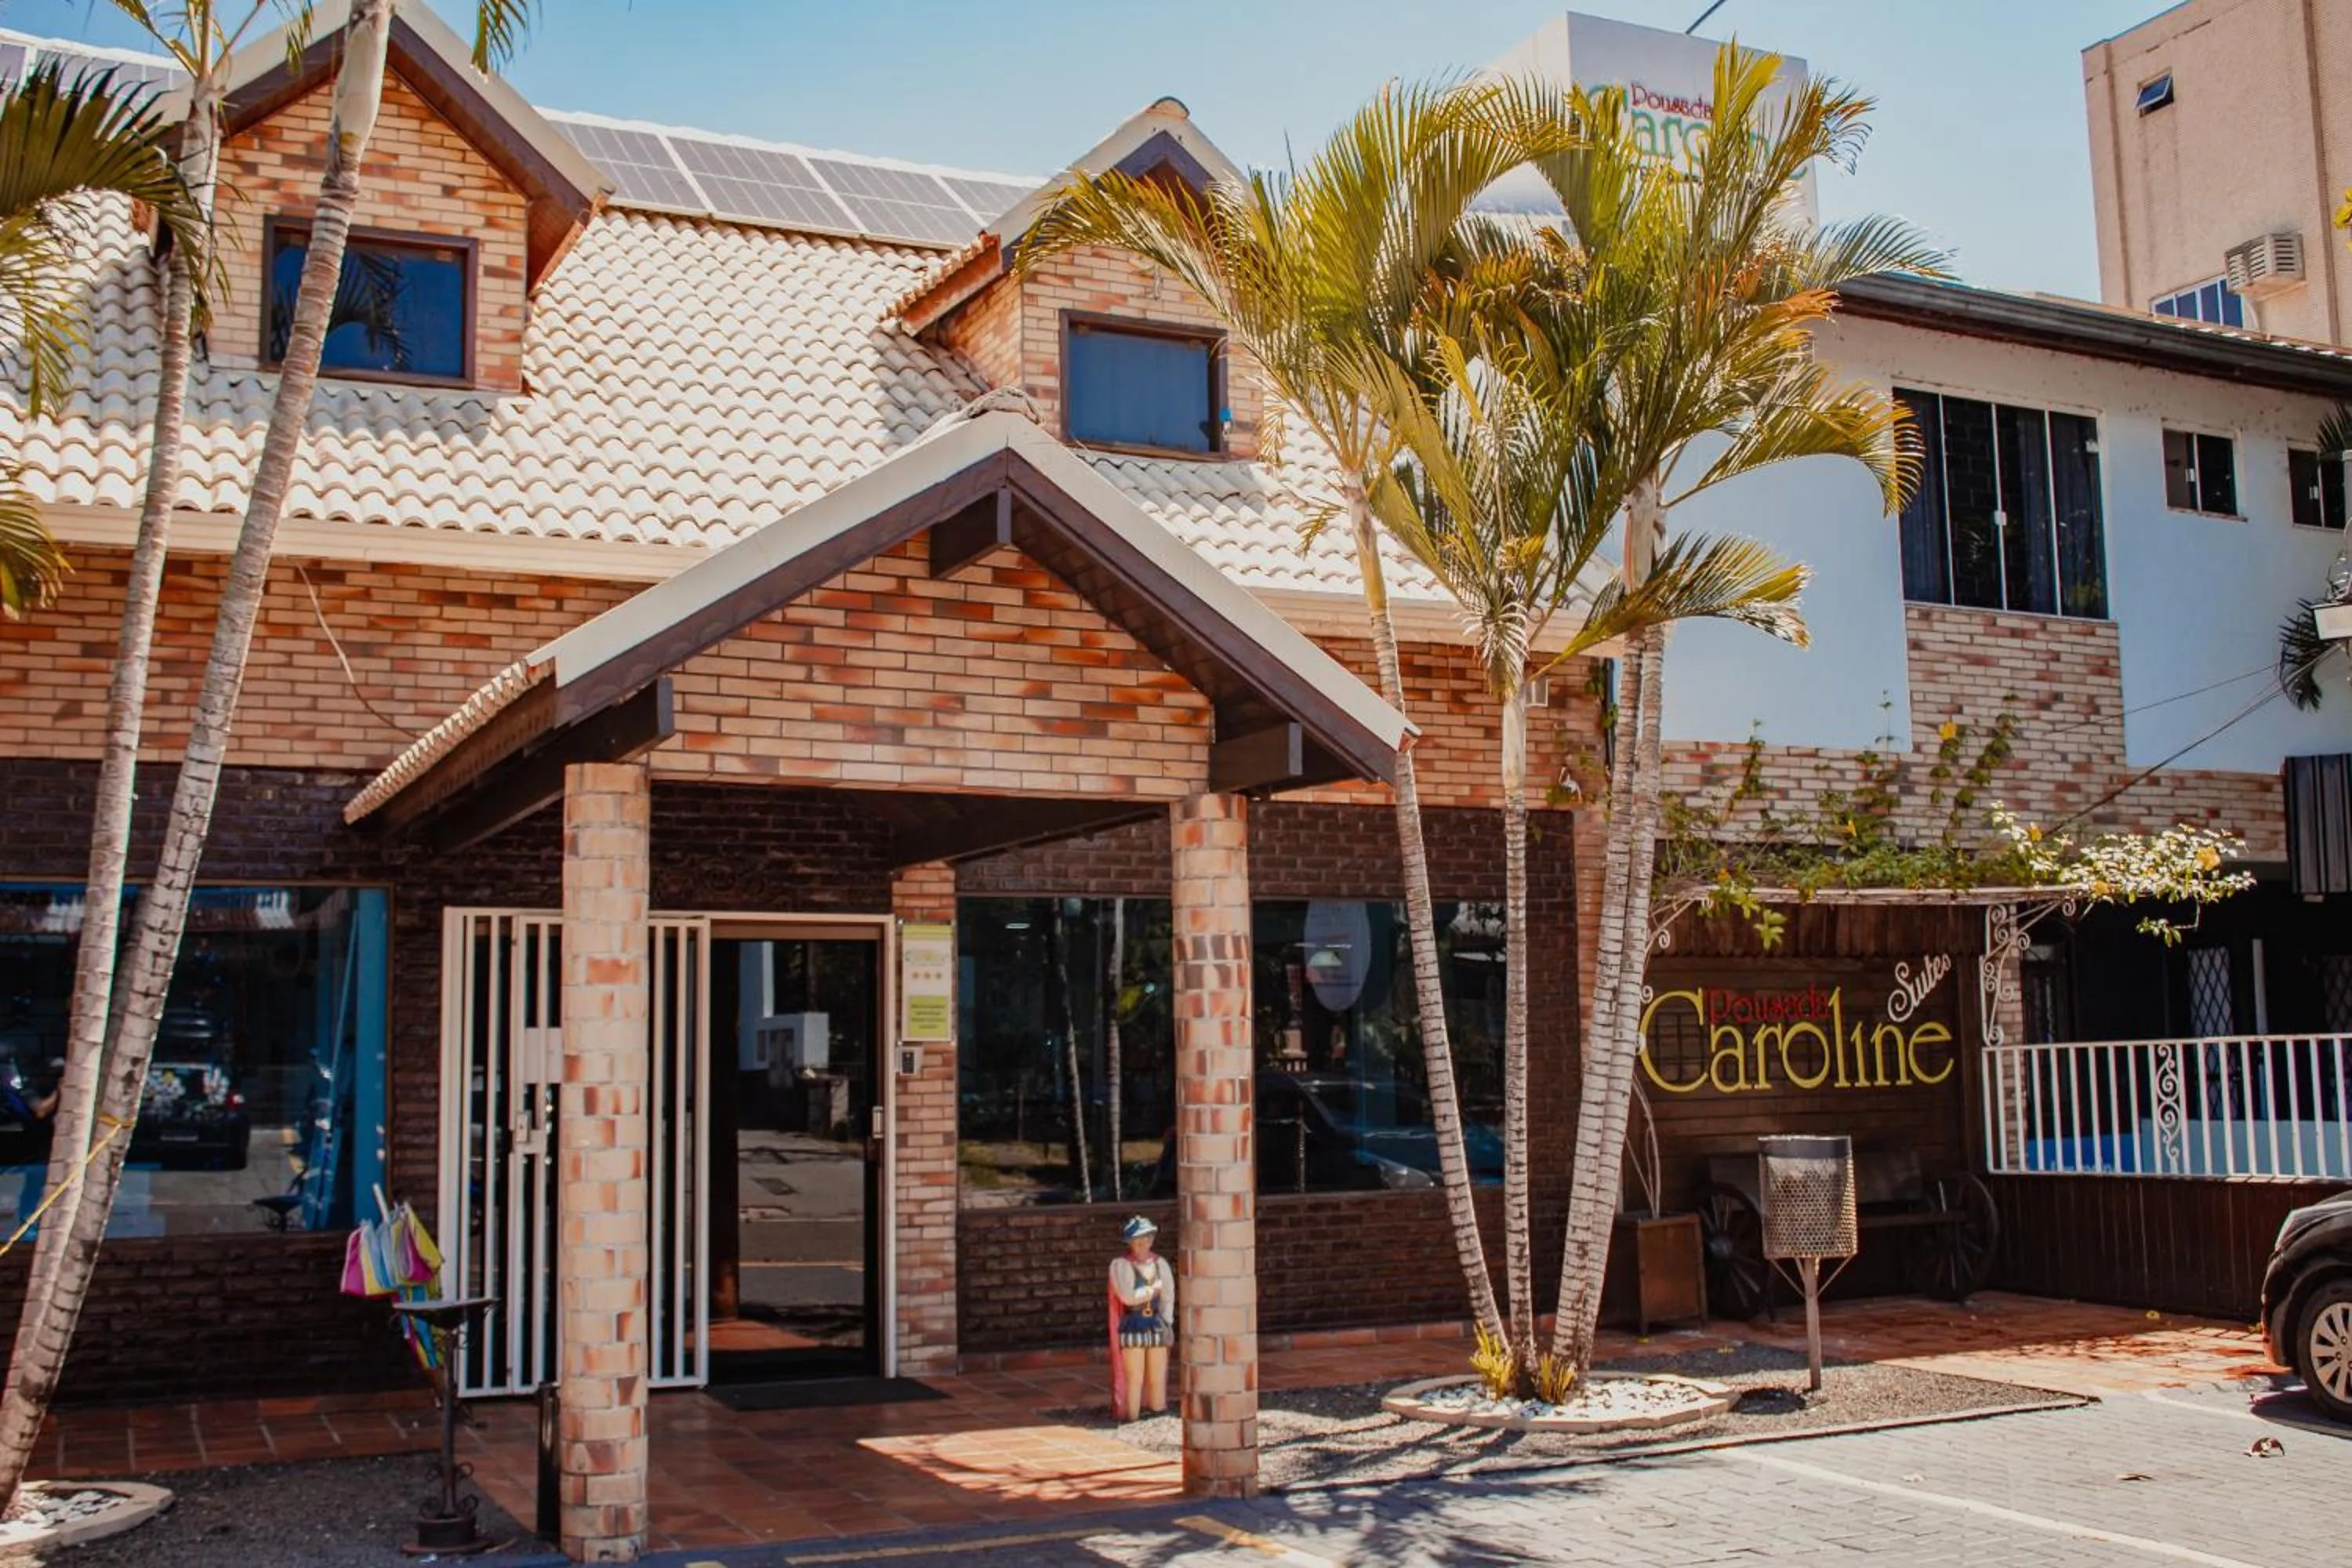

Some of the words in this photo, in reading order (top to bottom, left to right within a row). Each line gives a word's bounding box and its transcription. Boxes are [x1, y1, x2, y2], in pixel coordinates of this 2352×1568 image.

[1708, 981, 1831, 1025] Pousada
[1887, 953, 1951, 1022] Suites
[1639, 987, 1954, 1093] Caroline
